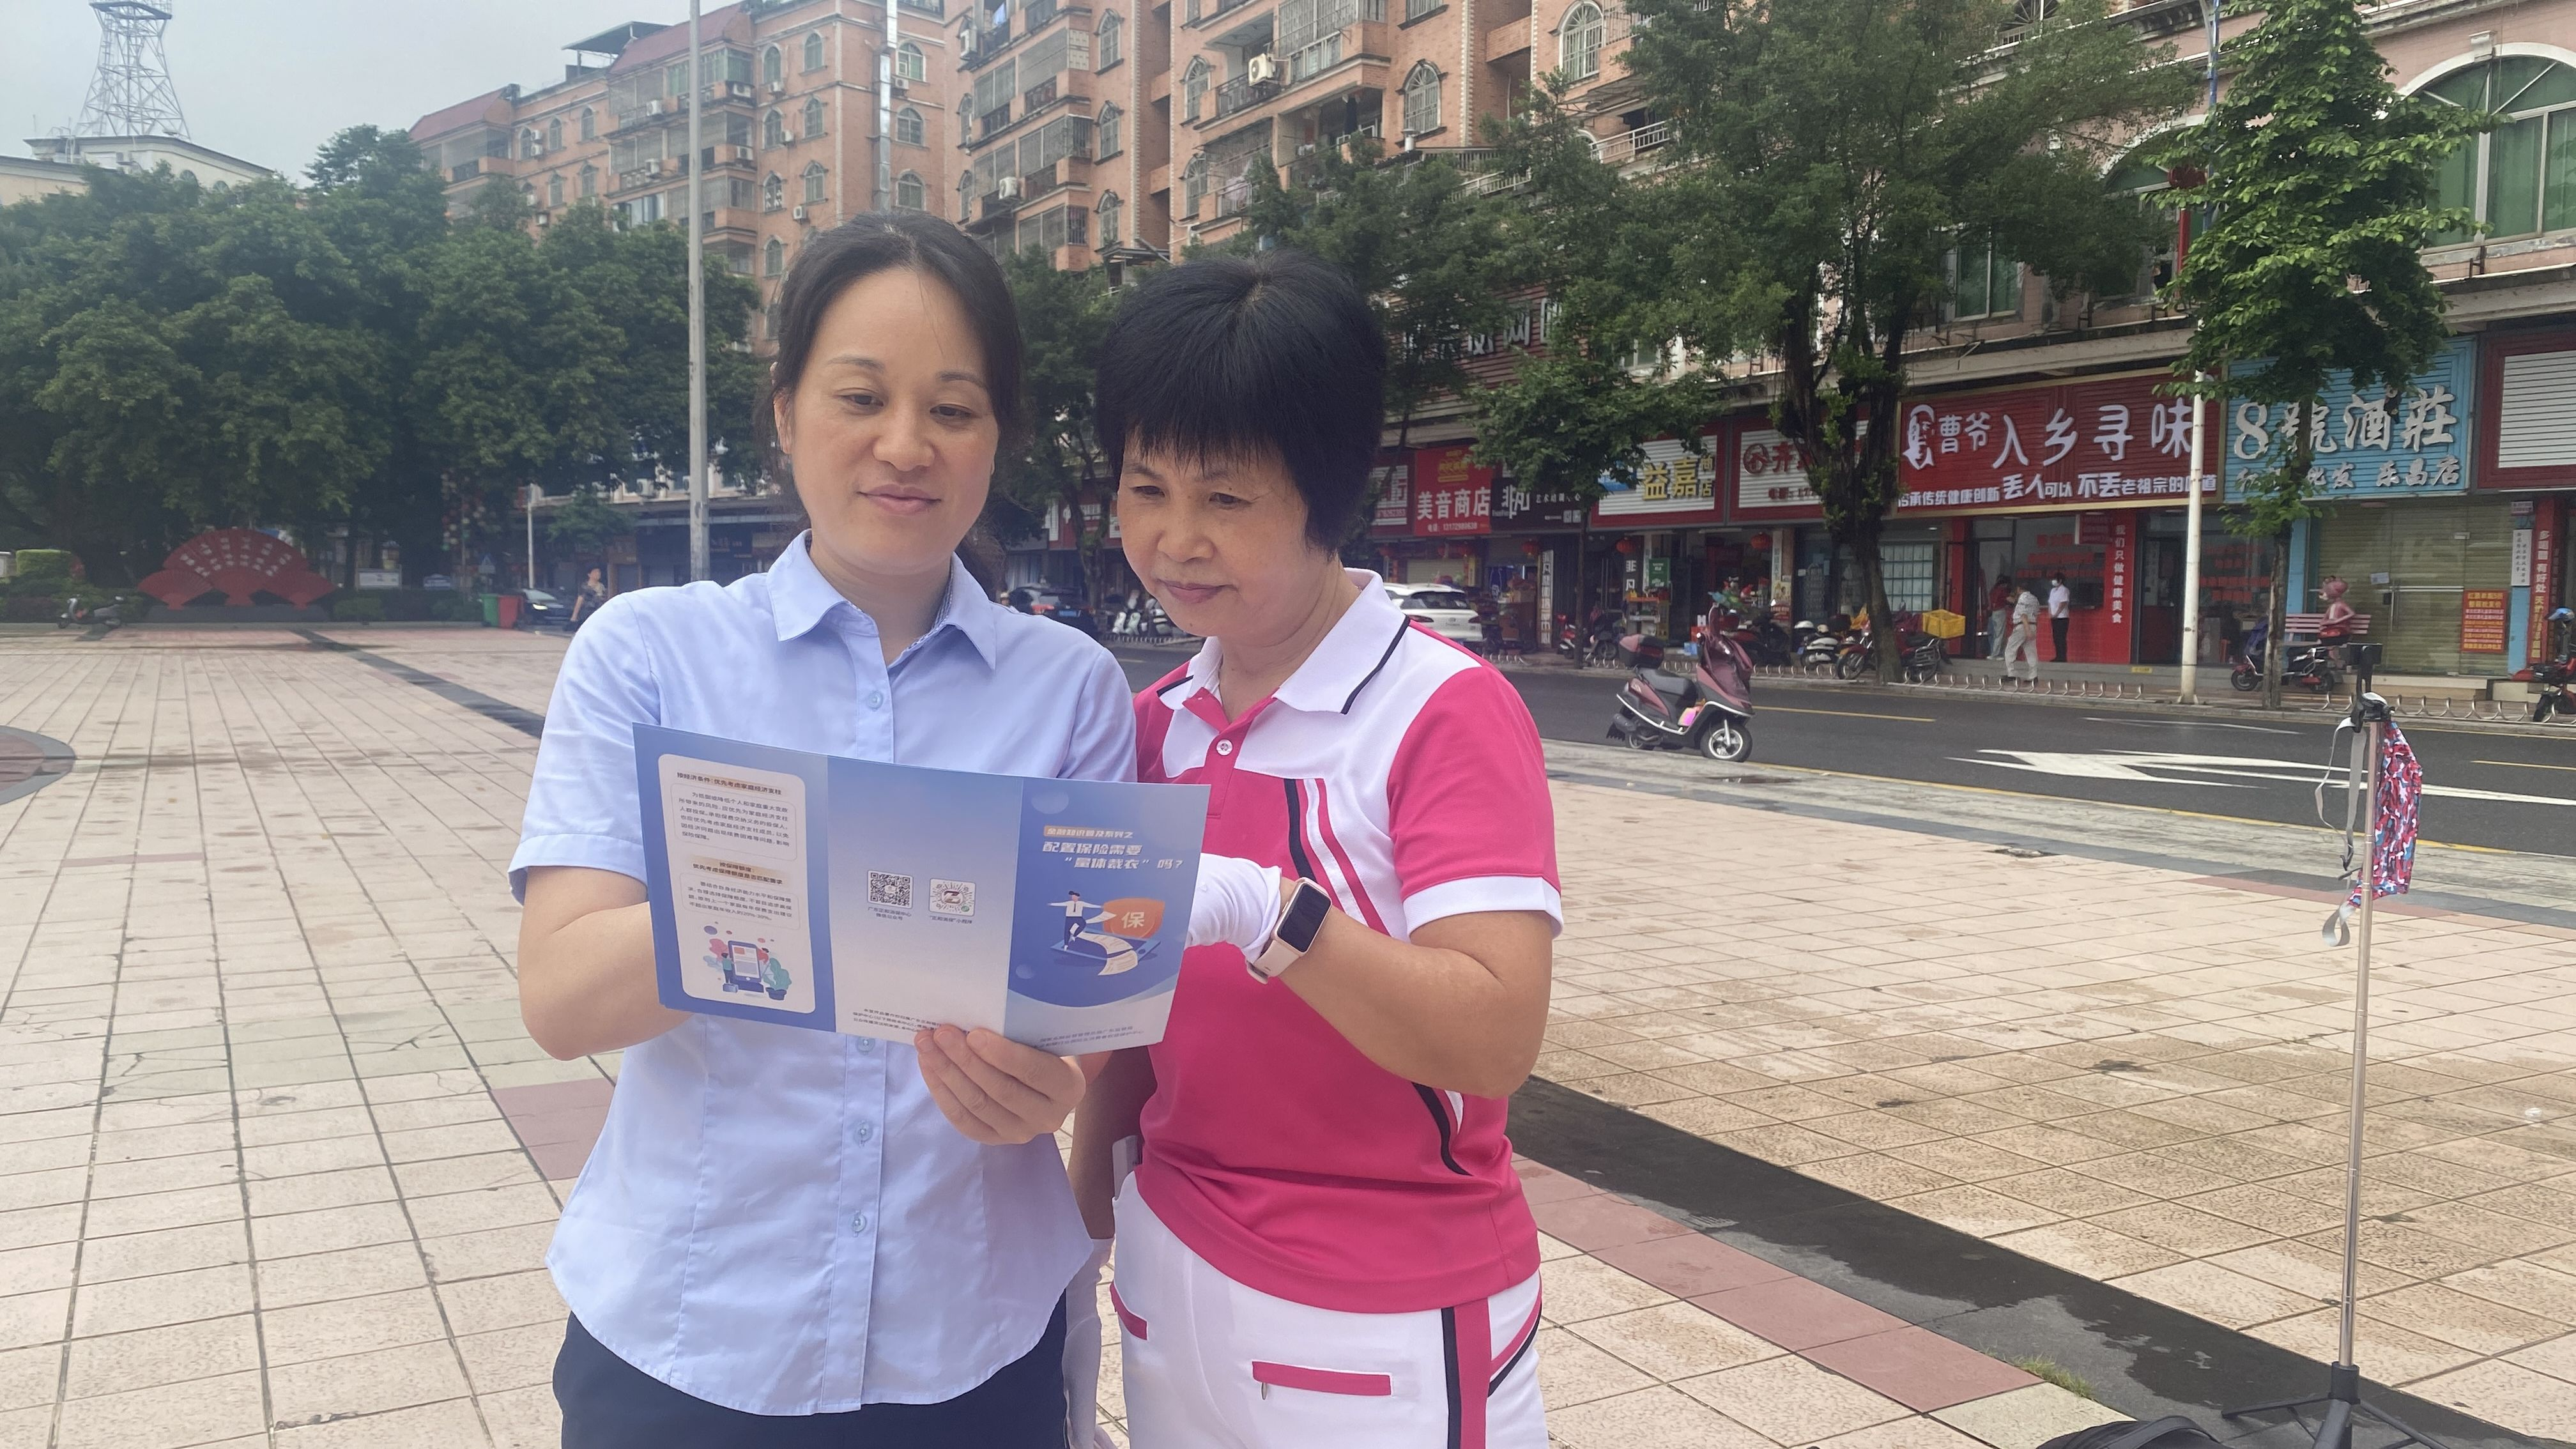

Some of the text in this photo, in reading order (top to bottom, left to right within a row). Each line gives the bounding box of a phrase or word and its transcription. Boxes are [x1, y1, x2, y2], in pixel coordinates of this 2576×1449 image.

[1643, 456, 1699, 500] 益嘉
[2376, 455, 2460, 487] 乐昌店
[1417, 487, 1491, 520] 美音商店
[2112, 525, 2126, 624] 我们只做健康美食
[1043, 841, 1142, 855] 配置保险需要
[1122, 912, 1145, 928] 保
